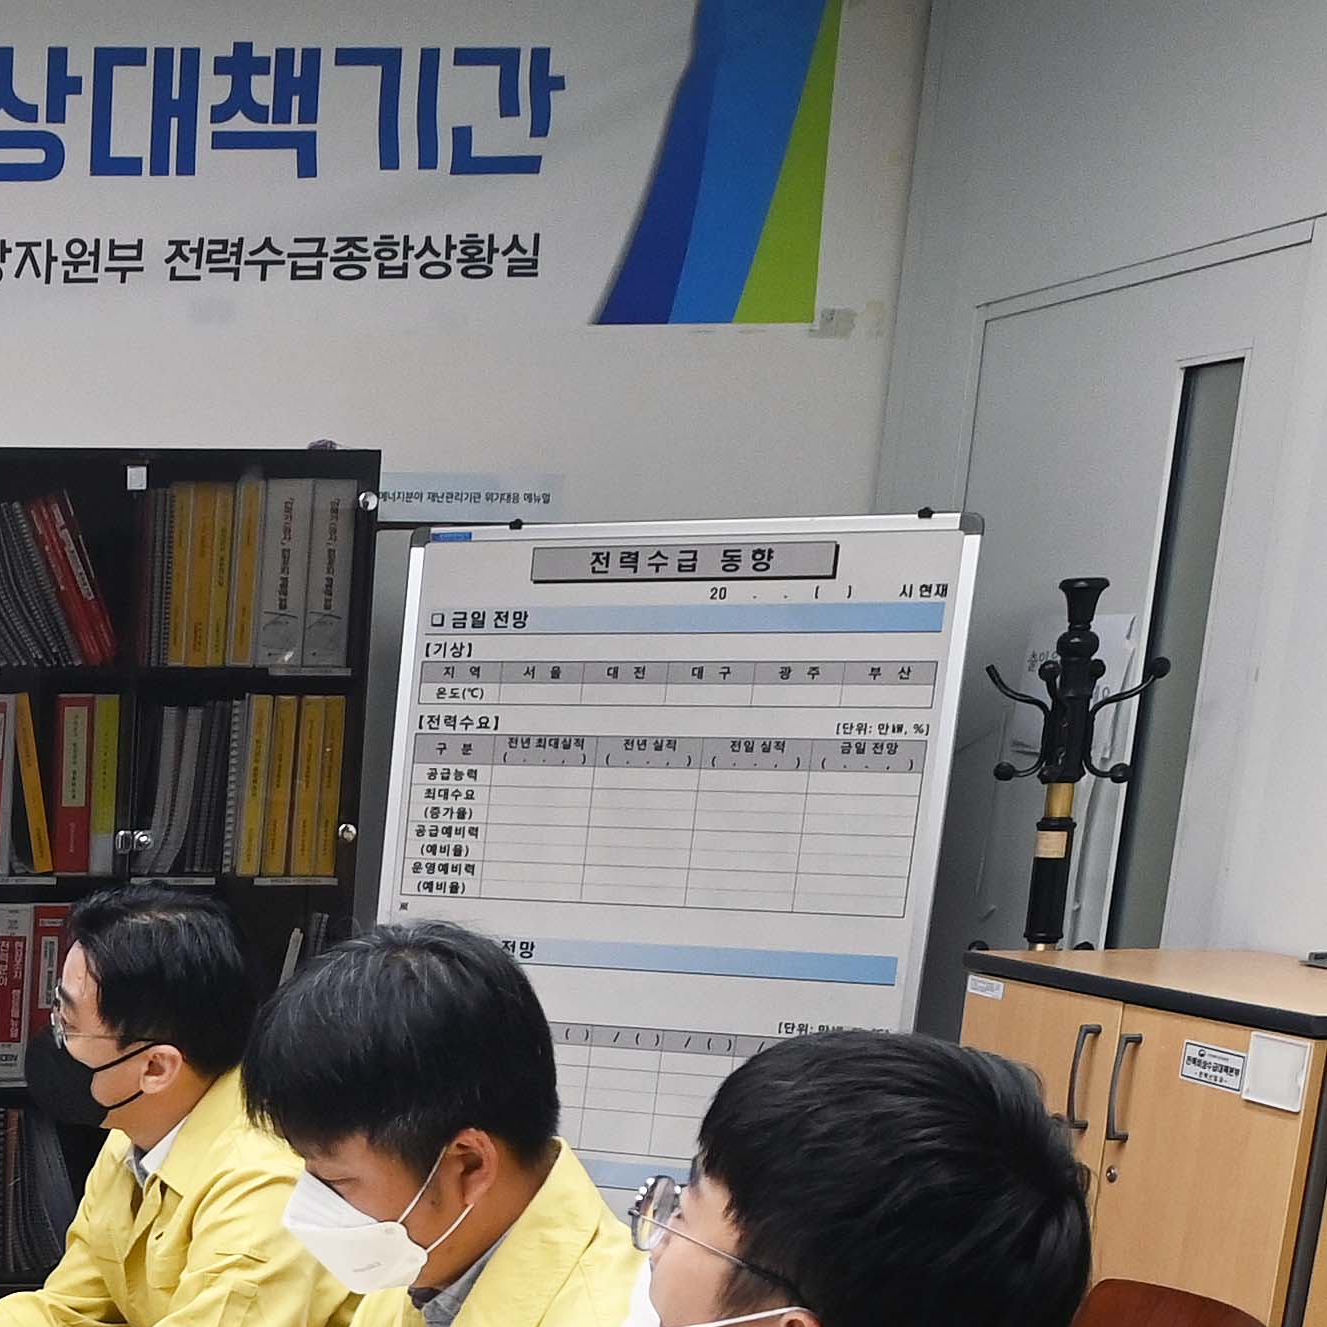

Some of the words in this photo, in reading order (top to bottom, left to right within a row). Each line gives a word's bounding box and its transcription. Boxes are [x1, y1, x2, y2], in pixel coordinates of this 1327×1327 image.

[163, 233, 542, 281] 전력수급종합상황실
[589, 550, 699, 574] 전력수급
[720, 547, 776, 572] 동향
[710, 587, 727, 600] 20
[900, 584, 914, 599] 시
[917, 582, 948, 599] 현재
[451, 611, 487, 629] 금일
[493, 610, 529, 629] 전망
[508, 737, 531, 749] 전년
[535, 737, 585, 750] 최대실적
[623, 738, 647, 750] 전년
[653, 739, 677, 751] 실적
[730, 740, 755, 752] 전일
[761, 740, 786, 753] 실적
[841, 741, 866, 753] 금일
[872, 742, 898, 754] 전망
[426, 767, 478, 781] 공급능력
[424, 787, 475, 801] 최대수요
[424, 806, 473, 820] (증가율)
[415, 824, 479, 839] 공급예비력
[420, 843, 469, 857] (예비율)
[411, 861, 476, 876] 운영예비력
[416, 880, 466, 894] (예비율)
